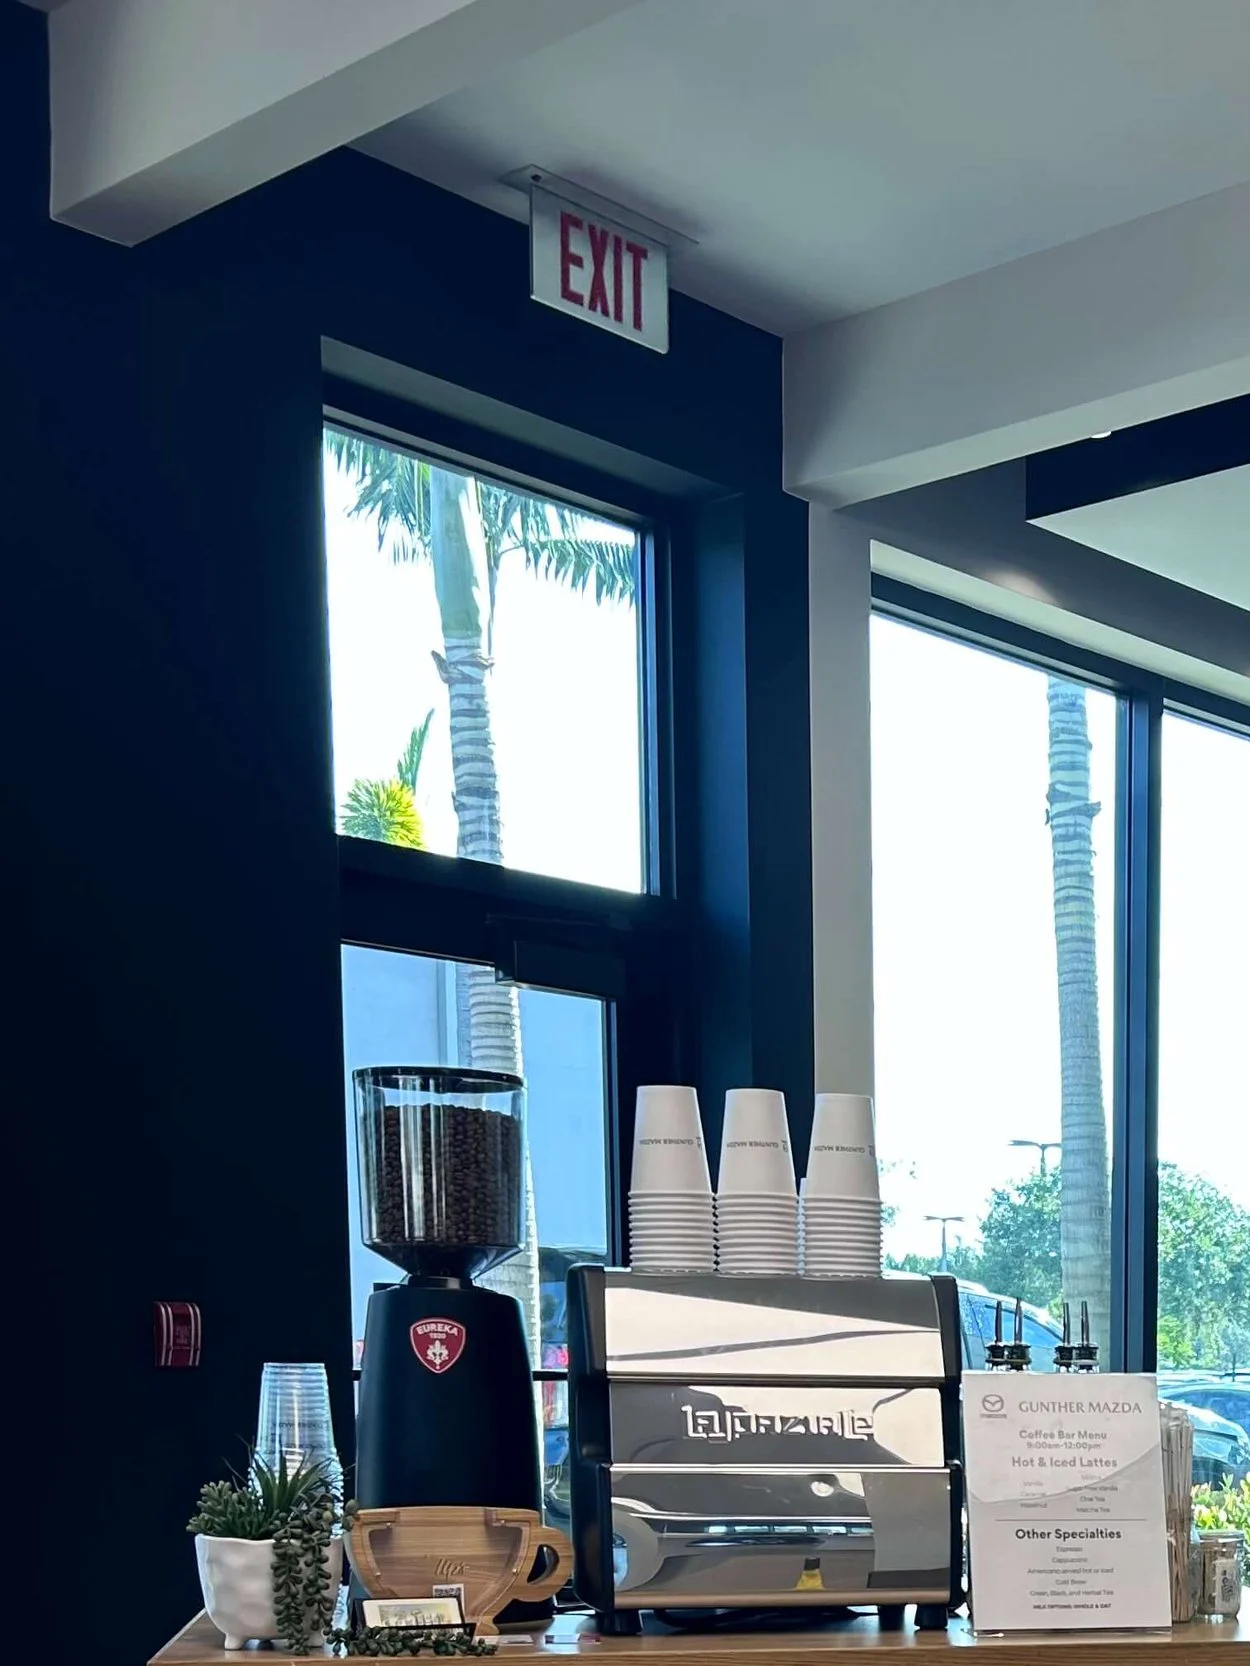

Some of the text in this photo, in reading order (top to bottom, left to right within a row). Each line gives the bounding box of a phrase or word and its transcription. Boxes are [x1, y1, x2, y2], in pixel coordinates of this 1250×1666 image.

[561, 210, 648, 332] EXIT
[416, 1323, 458, 1336] EUREKA
[1018, 1400, 1142, 1414] GUNTHER MAZDA
[1018, 1429, 1107, 1440] Coffee Bar Menu
[1011, 1456, 1118, 1468] Hot & Iced Lattes
[1015, 1527, 1122, 1542] Other Specialties
